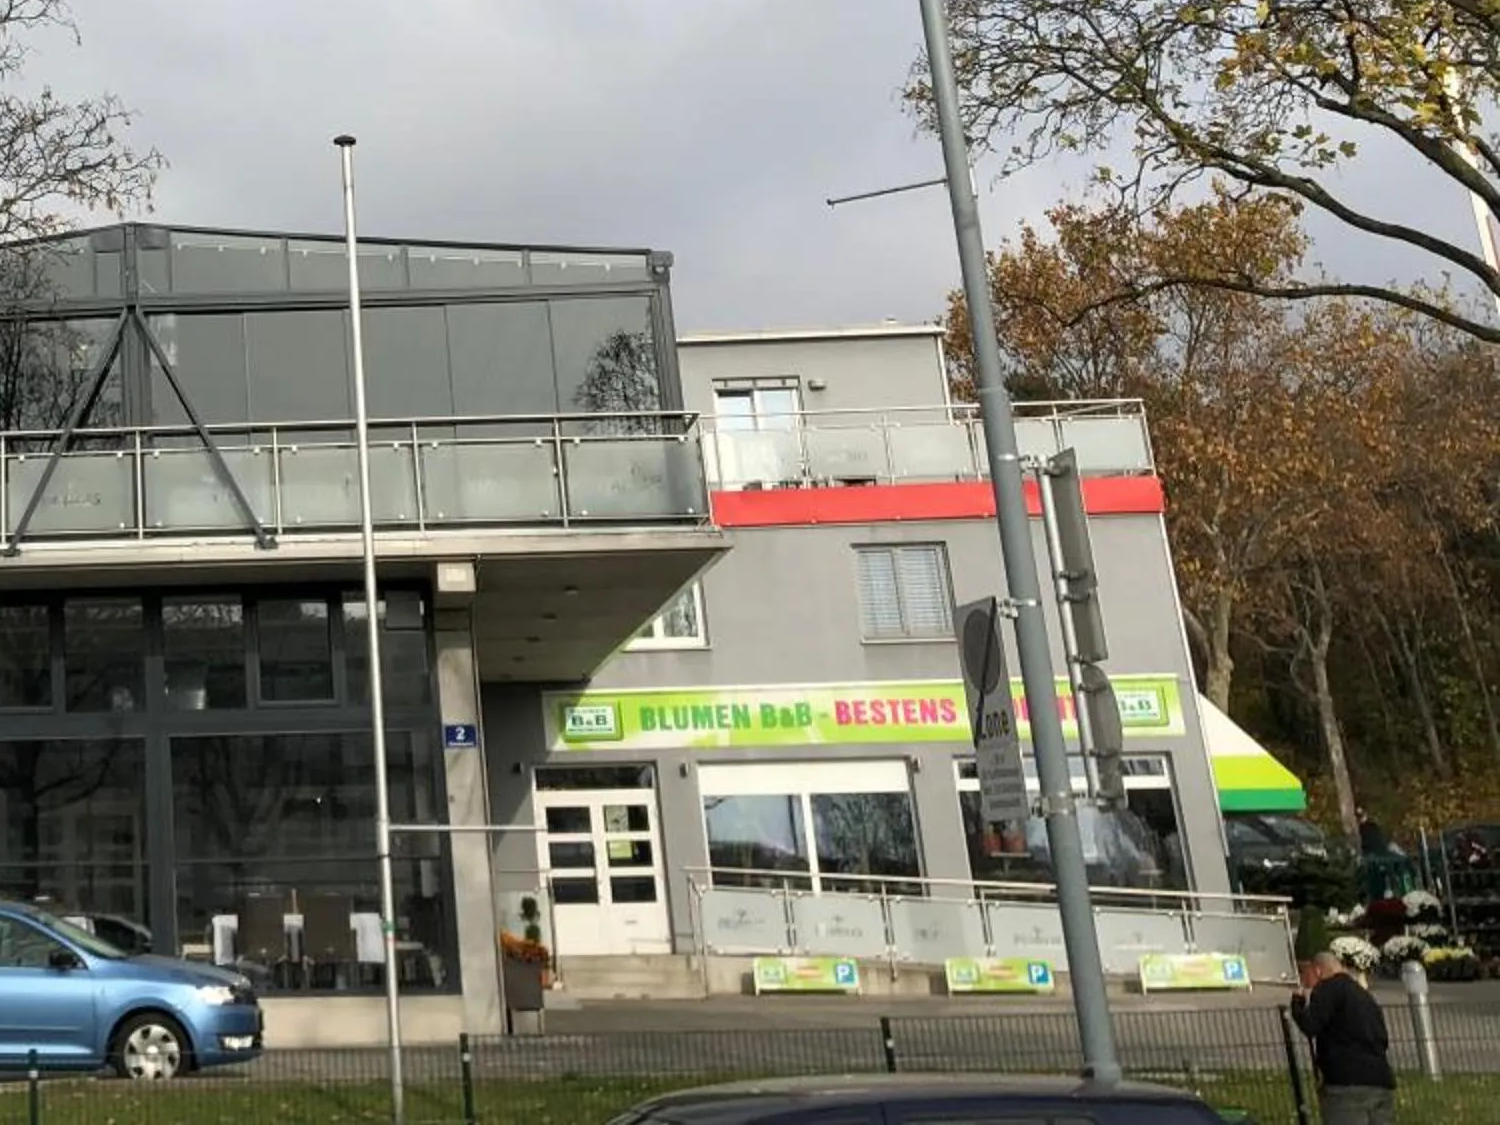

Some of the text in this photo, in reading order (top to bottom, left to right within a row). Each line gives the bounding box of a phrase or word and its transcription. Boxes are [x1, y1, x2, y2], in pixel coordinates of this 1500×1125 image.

[571, 714, 608, 725] B&B
[640, 703, 750, 731] BLUMEN
[759, 702, 812, 728] B&B
[835, 698, 957, 726] BESTENS
[455, 726, 465, 740] 2
[836, 963, 852, 982] P
[1030, 965, 1046, 985] P
